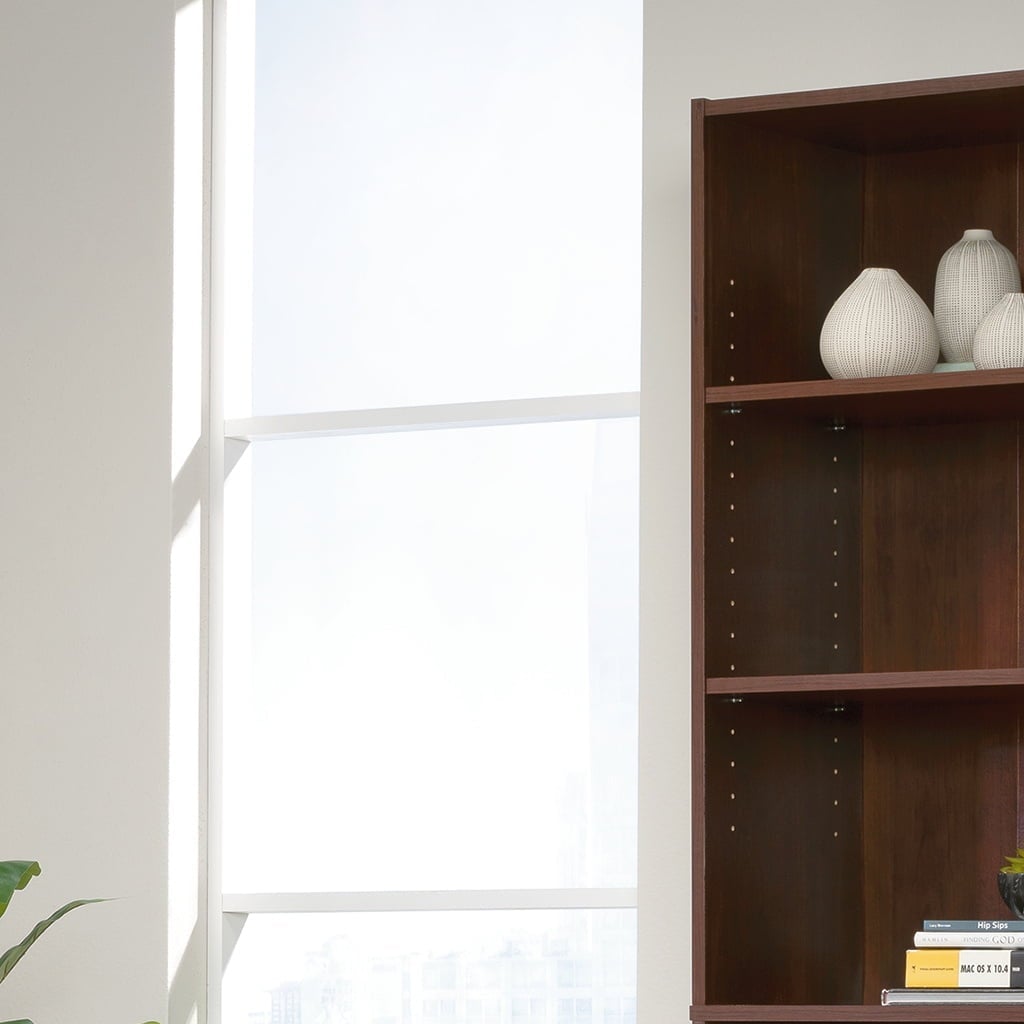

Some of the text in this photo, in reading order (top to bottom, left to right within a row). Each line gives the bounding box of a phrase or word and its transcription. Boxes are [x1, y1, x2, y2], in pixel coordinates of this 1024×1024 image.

[977, 921, 1009, 930] Hip Sips
[992, 935, 1015, 944] GOD
[960, 964, 975, 973] MAC
[976, 964, 985, 973] OS
[986, 964, 992, 973] X
[994, 964, 1009, 973] 10.4
